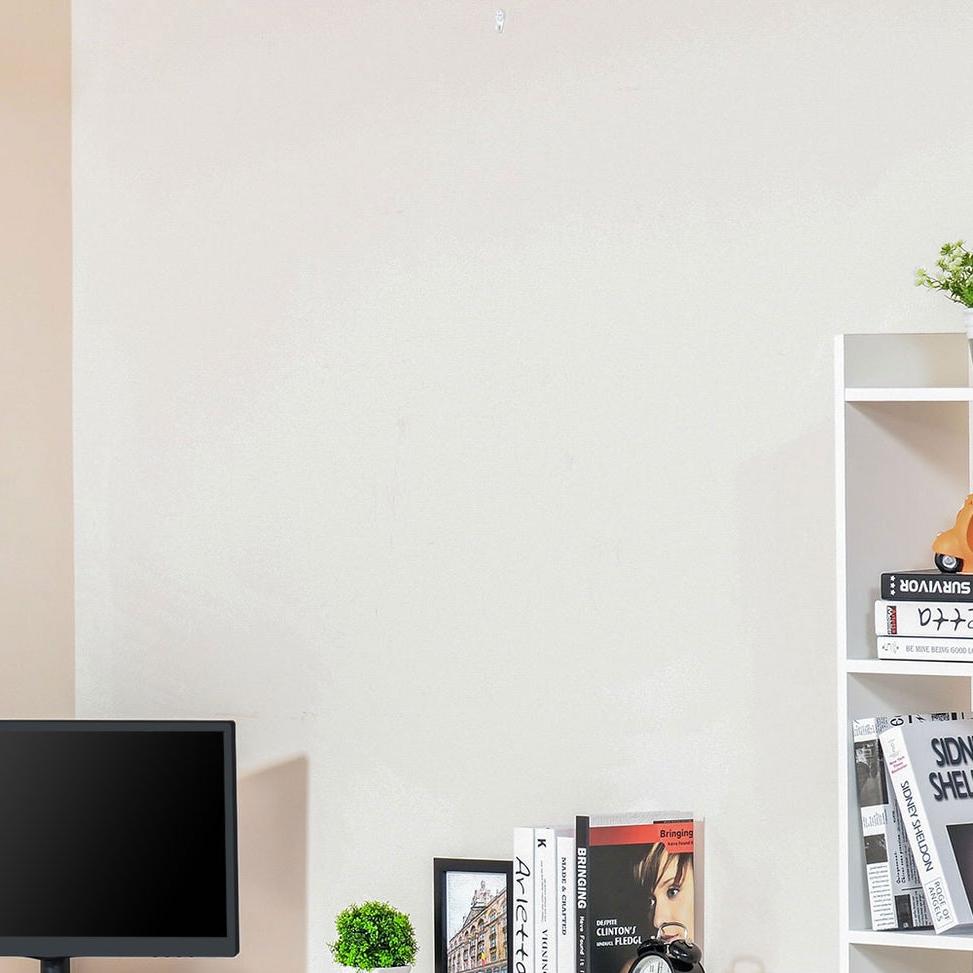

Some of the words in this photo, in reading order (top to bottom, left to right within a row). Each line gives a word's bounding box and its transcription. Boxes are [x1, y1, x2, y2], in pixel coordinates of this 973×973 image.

[900, 579, 970, 594] SURVIVOR
[931, 736, 973, 768] SIDN
[928, 770, 973, 802] SHEL
[660, 828, 693, 839] Bringing
[900, 780, 918, 818] SIDNEY
[912, 820, 934, 872] SHELDON
[538, 838, 547, 848] K
[578, 848, 587, 909] BRINGING
[928, 887, 943, 922] ANGELS
[596, 926, 636, 936] CLINTON'S
